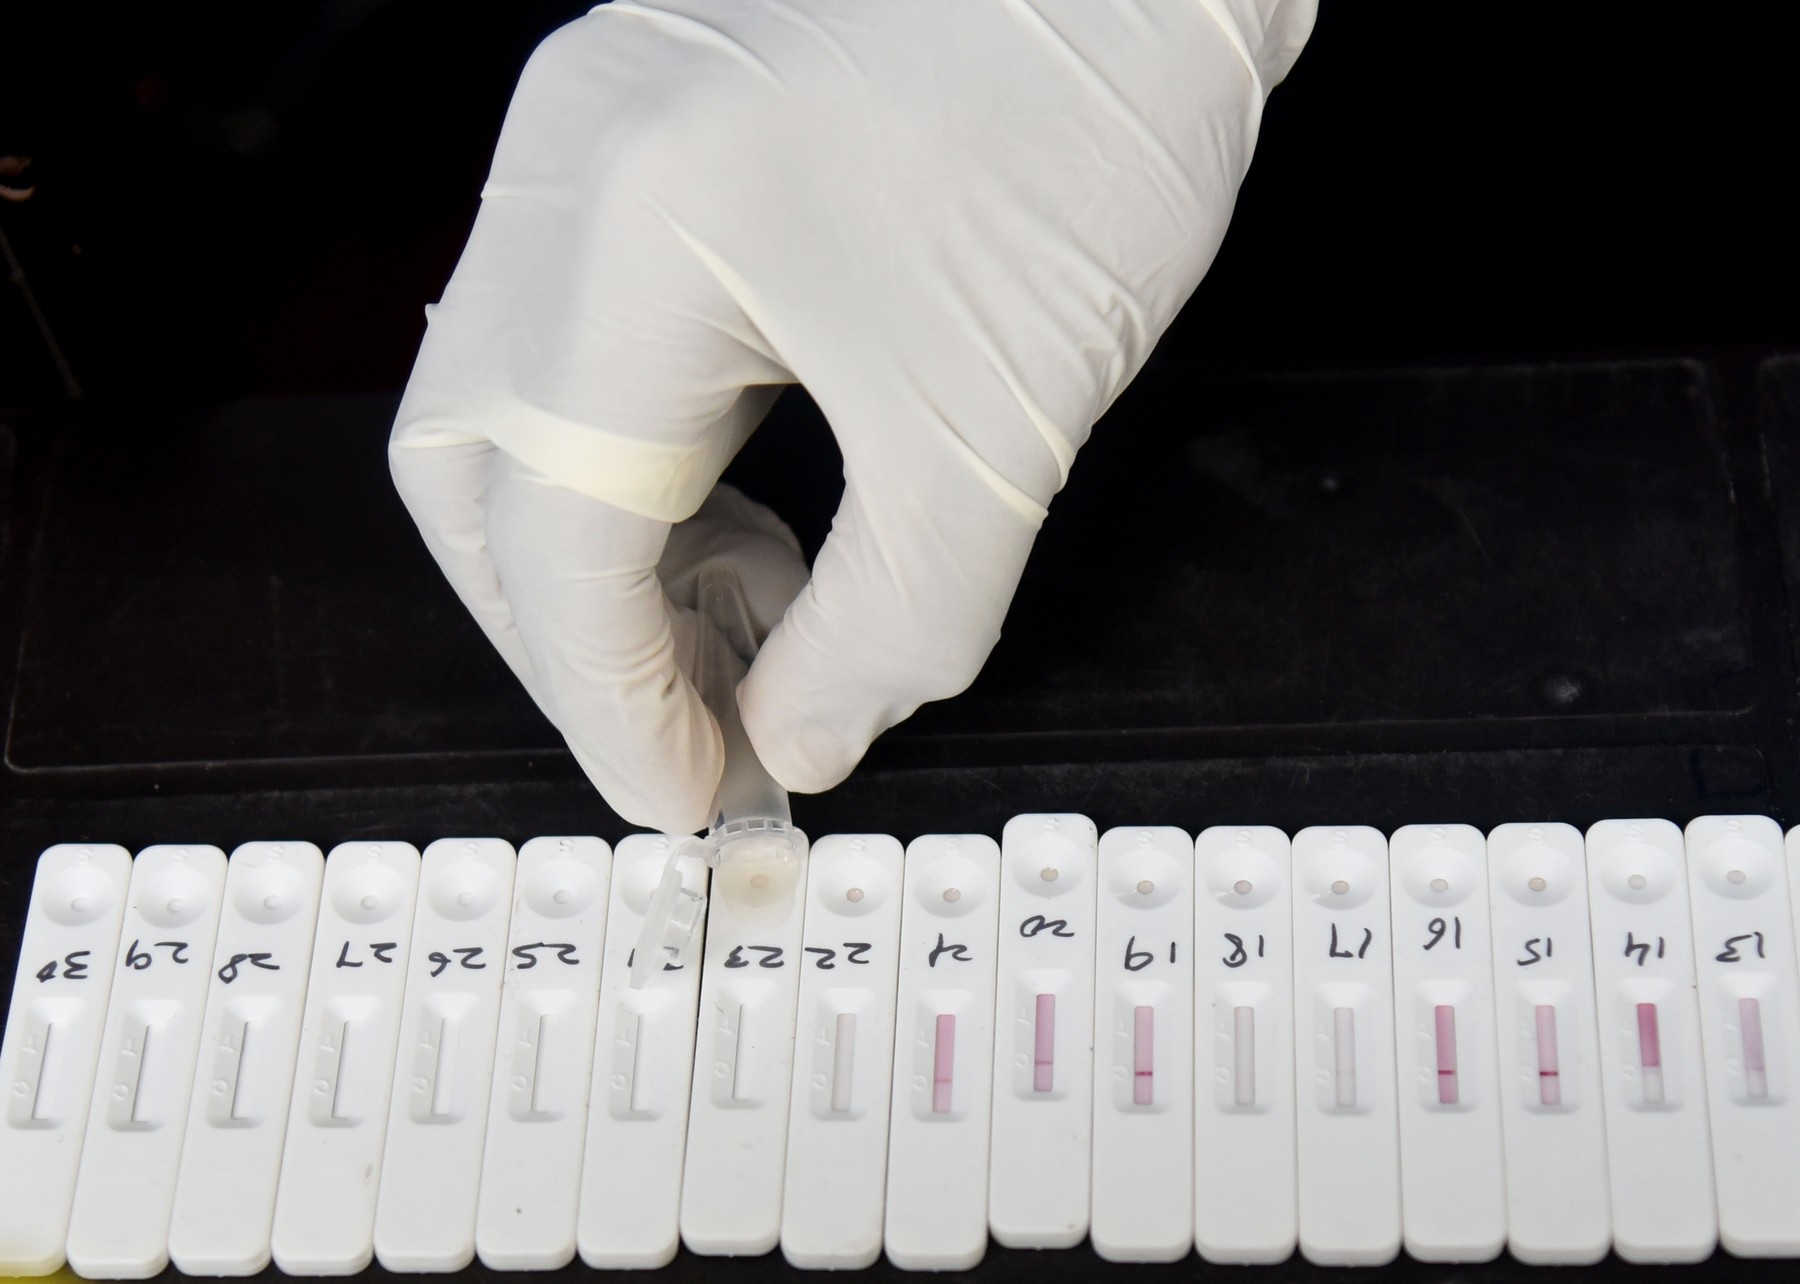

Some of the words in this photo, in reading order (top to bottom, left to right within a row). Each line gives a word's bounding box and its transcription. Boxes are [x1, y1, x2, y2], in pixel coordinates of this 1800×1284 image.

[1330, 923, 1372, 959] 17
[1423, 917, 1461, 950] 16
[1716, 932, 1764, 962] 13
[126, 940, 188, 970] 29
[336, 941, 397, 968] 27
[429, 947, 486, 977] 26
[512, 942, 579, 969] 25
[724, 946, 784, 968] 23
[805, 943, 871, 969] 22
[1124, 936, 1175, 971] 19
[1223, 933, 1264, 968] 18
[1517, 938, 1552, 966] 15
[1625, 932, 1664, 966] 14
[218, 953, 280, 984] 28
